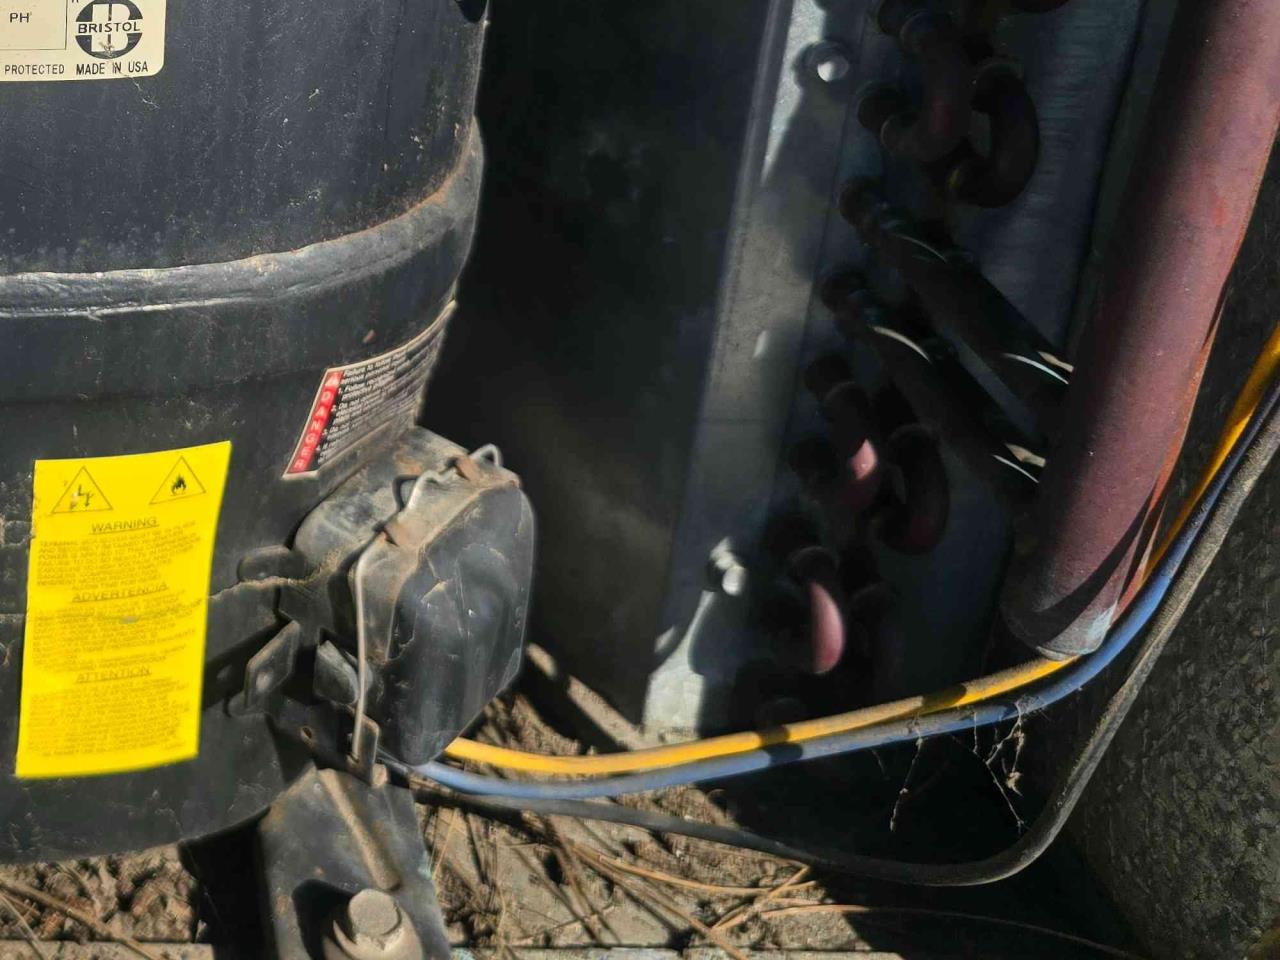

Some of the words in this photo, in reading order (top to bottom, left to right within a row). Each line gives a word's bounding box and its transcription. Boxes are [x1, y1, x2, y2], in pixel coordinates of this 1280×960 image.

[9, 12, 31, 23] PH
[77, 21, 141, 34] BRISTOL
[4, 63, 65, 76] PROTECTED
[76, 62, 106, 76] MADE
[112, 61, 122, 75] IN
[128, 60, 149, 74] USA
[91, 516, 158, 533] WARNING
[75, 665, 152, 683] ATTENTION
